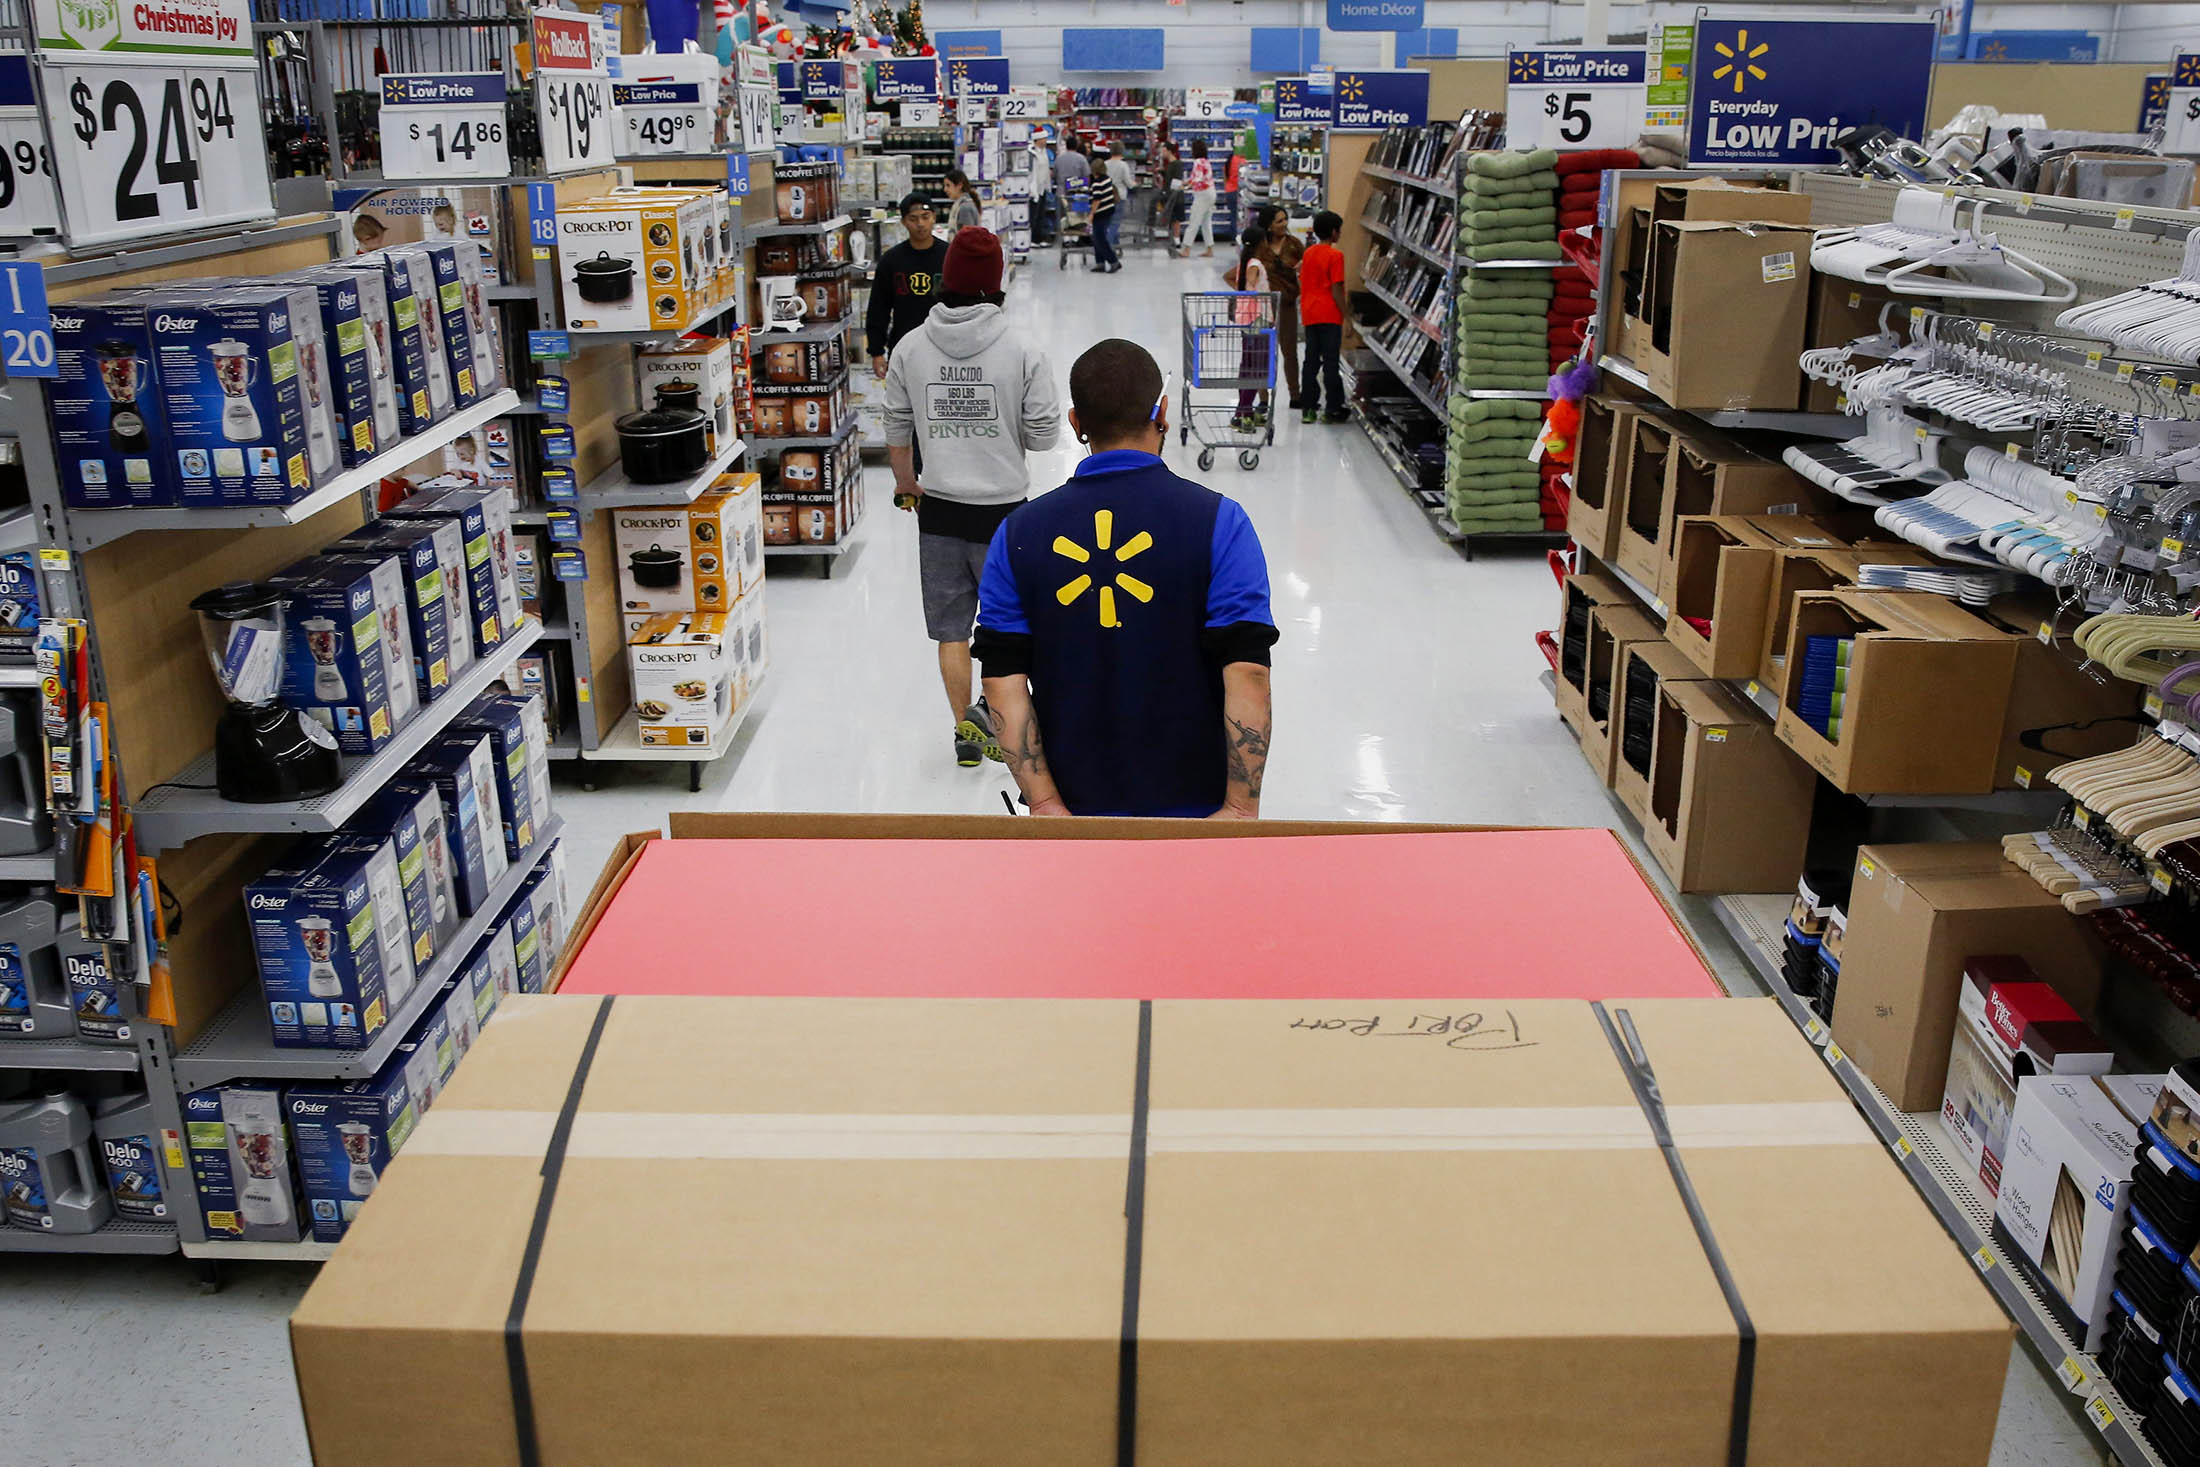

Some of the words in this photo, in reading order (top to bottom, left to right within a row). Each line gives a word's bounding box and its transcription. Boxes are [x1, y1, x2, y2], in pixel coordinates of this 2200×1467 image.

[1341, 3, 1378, 16] Home
[134, 4, 214, 34] Christmas
[215, 10, 237, 41] joy
[550, 31, 588, 59] Rollback
[1544, 61, 1582, 77] Low
[1584, 59, 1629, 77] Price
[408, 85, 438, 98] Low
[439, 83, 474, 97] Price
[631, 90, 651, 100] Low
[652, 89, 677, 100] Price
[901, 83, 925, 93] Price
[974, 82, 999, 93] Price
[1279, 108, 1302, 119] Low
[1303, 107, 1331, 118] Price
[1339, 102, 1369, 111] Everyday
[1709, 100, 1779, 118] Everyday
[1339, 109, 1371, 123] Low
[1372, 109, 1409, 124] Price
[1706, 117, 1782, 149] Low
[1787, 116, 1857, 150] Pri
[730, 177, 748, 192] 16
[367, 199, 388, 207] AIR
[391, 197, 449, 207] POWERED
[385, 207, 433, 216] HOCKEY
[532, 218, 555, 240] 18
[154, 314, 199, 333] Oster
[3, 329, 54, 368] 20
[940, 366, 983, 382] SALCIDO
[963, 387, 976, 399] LBS
[928, 424, 1000, 439] PINTOS
[250, 893, 289, 910] Oster
[67, 957, 105, 977] Delo
[71, 975, 98, 986] 400
[1990, 989, 2012, 1019] Better
[1994, 1007, 2019, 1039] Homes
[187, 1097, 219, 1111] Oster
[292, 1099, 329, 1115] Oster
[104, 1141, 140, 1160] Delo
[108, 1157, 133, 1168] 400
[2099, 1175, 2115, 1199] 20
[2010, 1185, 2031, 1215] Wood
[2012, 1200, 2039, 1238] Hangers
